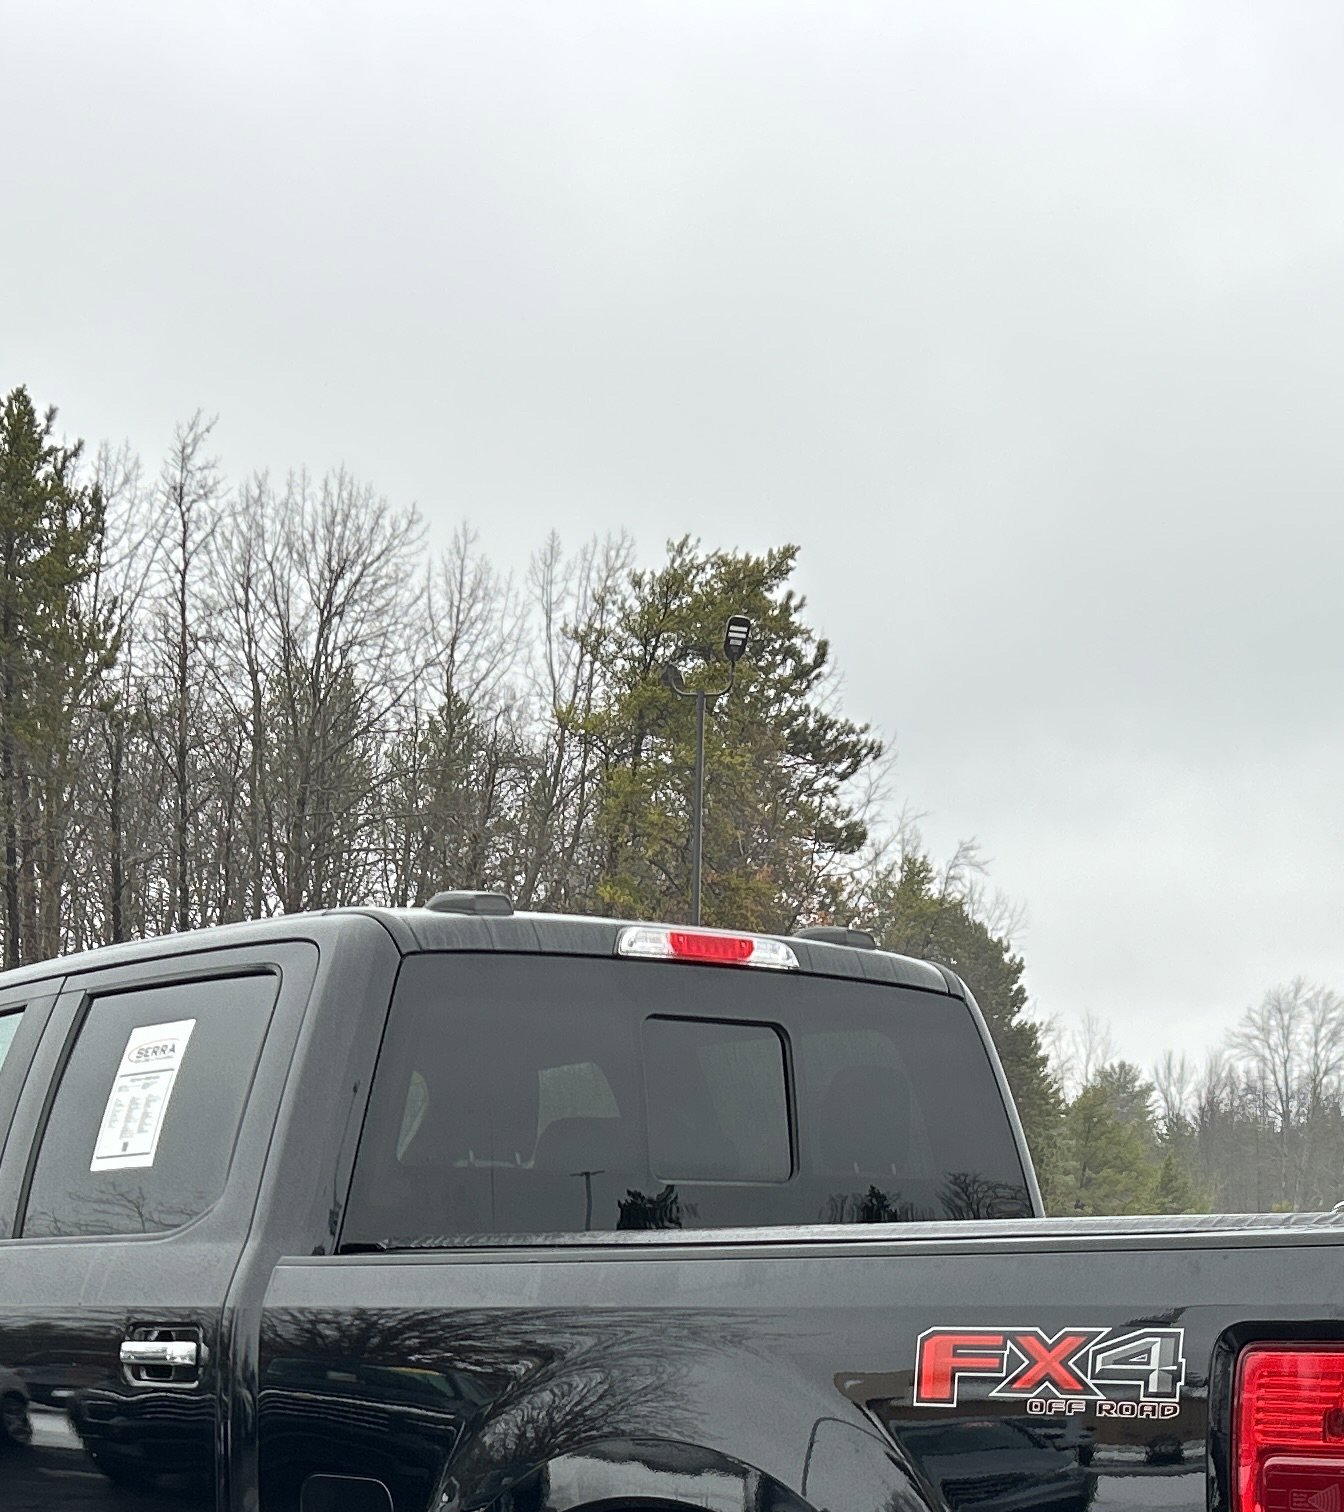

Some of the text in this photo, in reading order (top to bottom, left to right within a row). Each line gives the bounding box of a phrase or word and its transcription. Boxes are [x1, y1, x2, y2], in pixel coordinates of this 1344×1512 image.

[136, 1043, 176, 1059] SERRA
[913, 1326, 1186, 1408] FX4
[1026, 1398, 1181, 1419] OFF ROAD
